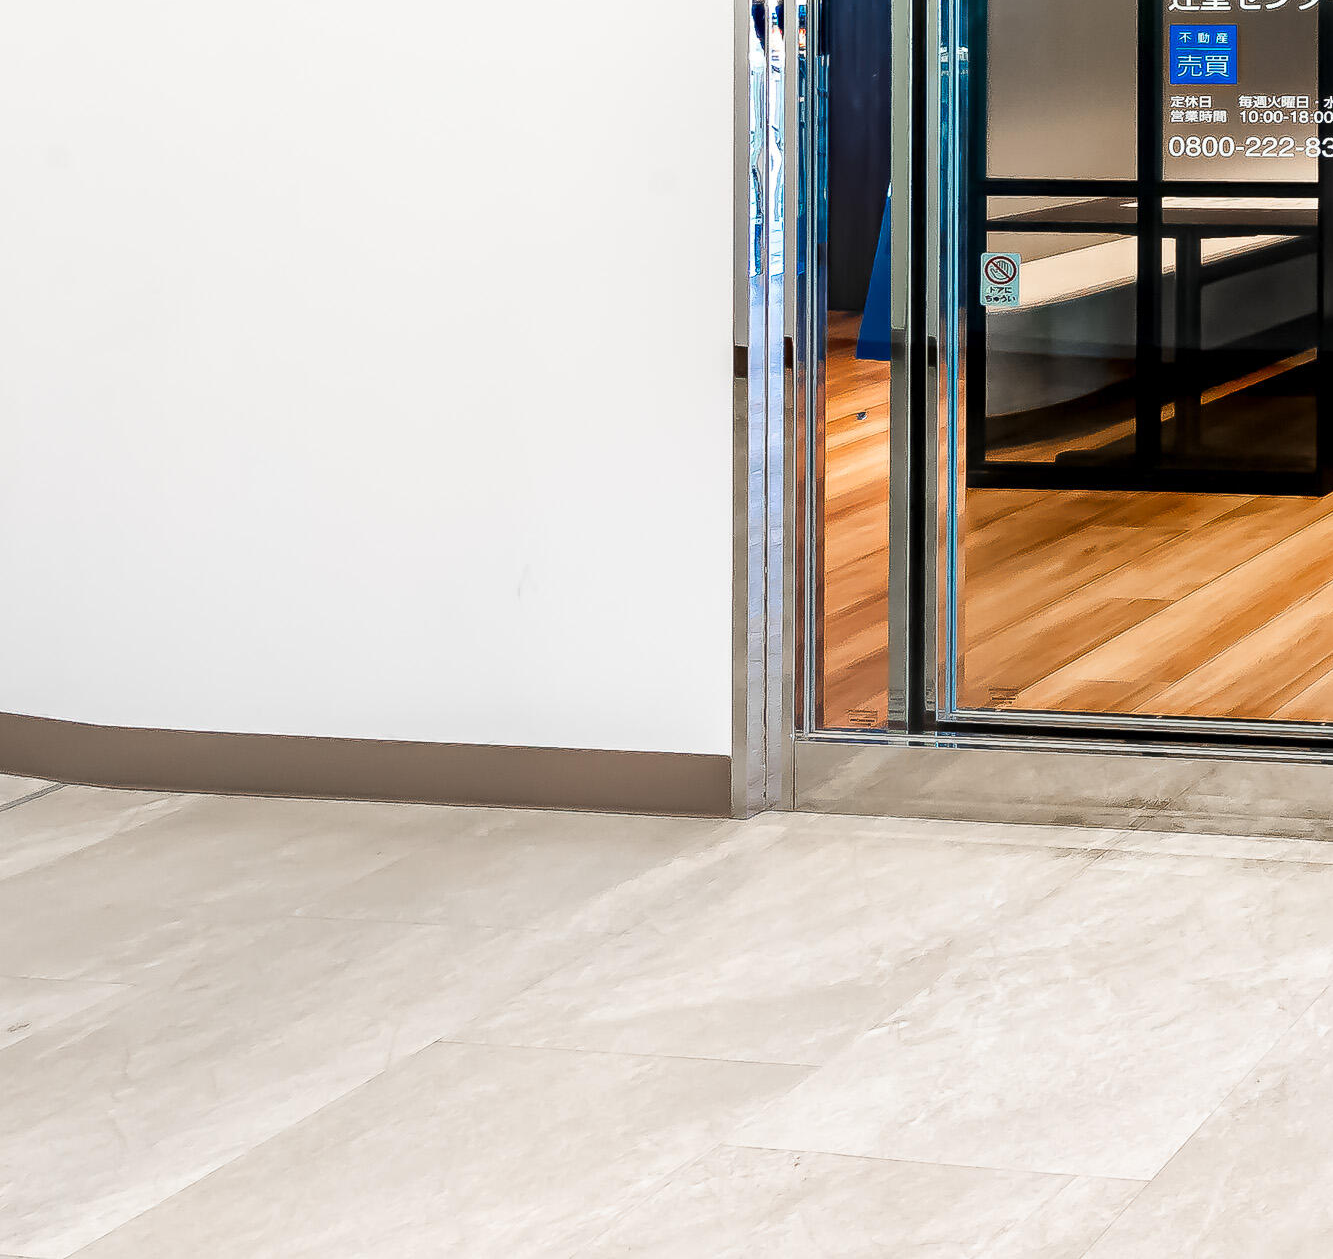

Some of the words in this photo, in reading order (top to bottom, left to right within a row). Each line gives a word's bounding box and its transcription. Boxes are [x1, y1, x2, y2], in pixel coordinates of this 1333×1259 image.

[1178, 32, 1229, 44] 不動産
[1177, 54, 1230, 77] 売買
[1170, 96, 1212, 109] 定休日
[1170, 111, 1227, 123] 営業時間
[1239, 111, 1333, 124] 10:00-18:00
